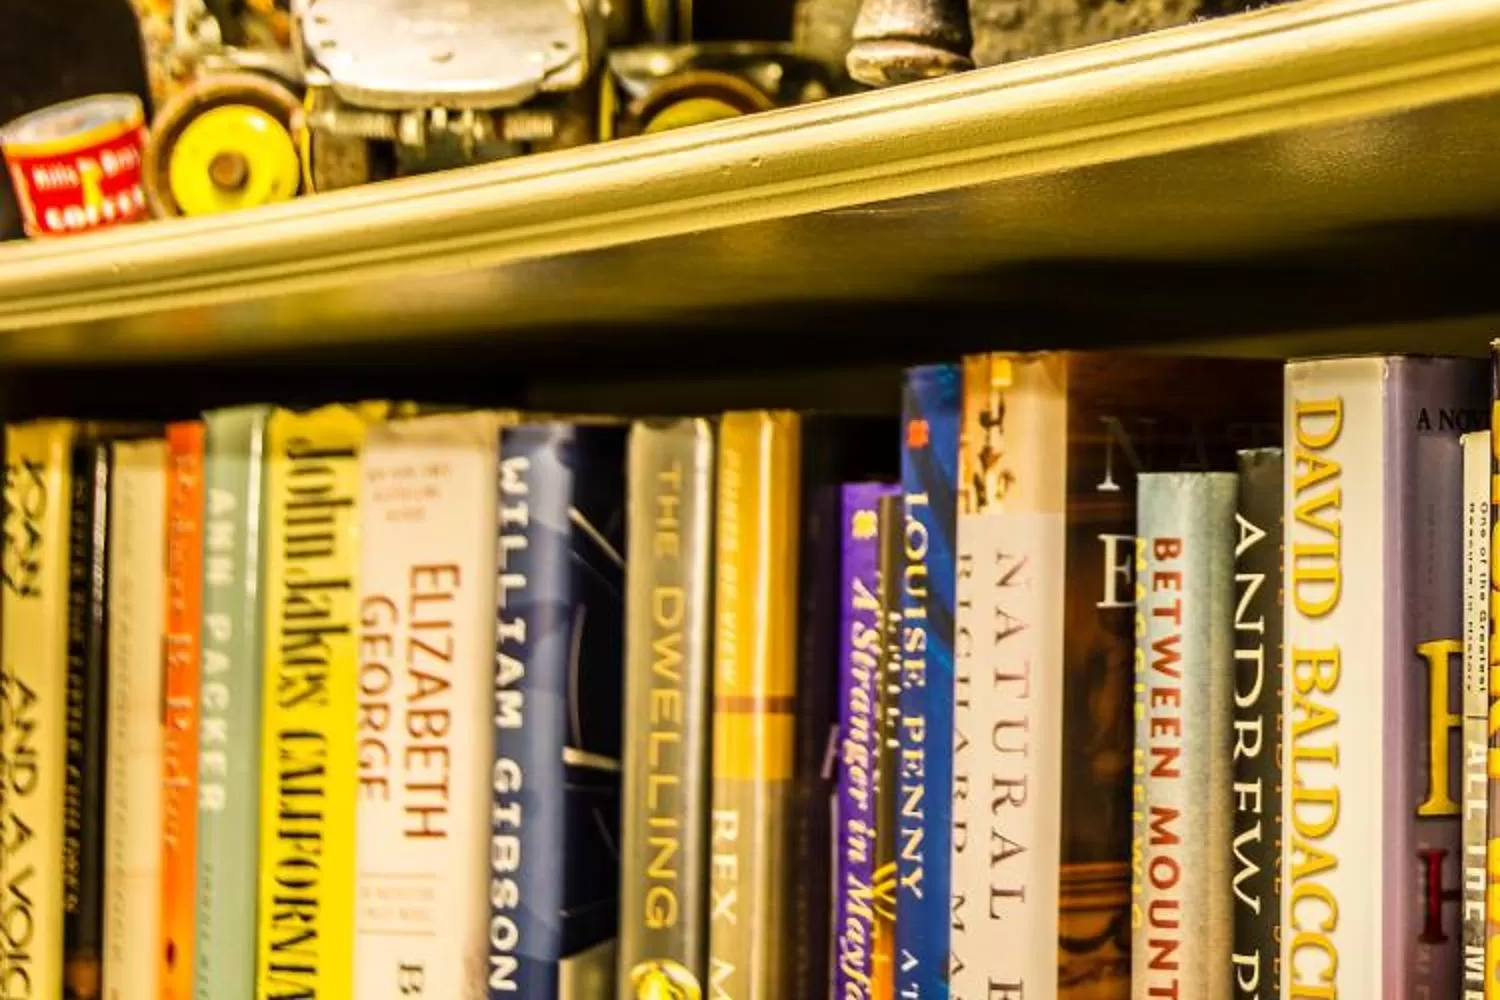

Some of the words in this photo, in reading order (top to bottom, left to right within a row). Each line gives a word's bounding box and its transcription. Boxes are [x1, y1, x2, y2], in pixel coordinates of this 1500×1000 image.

[285, 436, 357, 560] John
[652, 465, 682, 560] THE
[1291, 394, 1346, 622] DAVID
[1416, 406, 1433, 432] A
[494, 456, 531, 730] WILLIAM
[902, 492, 929, 690] LOUISE
[1478, 572, 1488, 602] the
[1479, 501, 1489, 539] One
[1479, 546, 1488, 565] of
[199, 612, 234, 813] PACKER
[358, 594, 400, 802] GEORGE
[404, 563, 462, 838] ELIZABETH
[843, 621, 882, 811] Stranger
[989, 551, 1031, 921] NATURAL
[1149, 537, 1184, 779] BETWEEN
[1232, 512, 1268, 916] ANDREW
[645, 586, 685, 931] DWELLING
[847, 819, 877, 864] in
[901, 714, 926, 900] PENNY
[1286, 640, 1343, 1000] BALDACCI
[1466, 739, 1488, 821] ALL
[488, 757, 523, 992] GIBSON
[711, 809, 739, 926] REX
[1147, 805, 1182, 1000] MOUNT
[1230, 949, 1261, 1000] P
